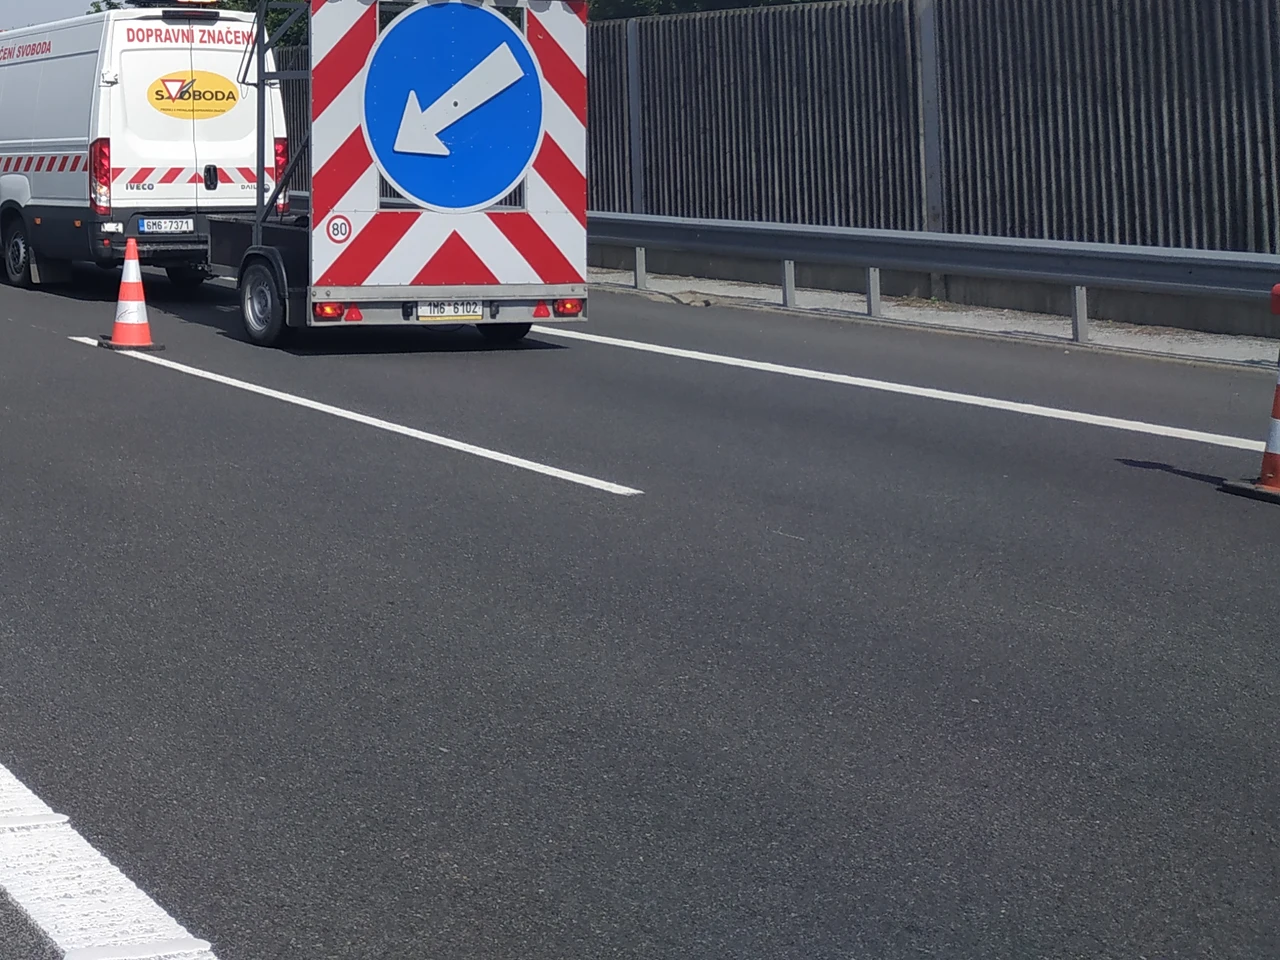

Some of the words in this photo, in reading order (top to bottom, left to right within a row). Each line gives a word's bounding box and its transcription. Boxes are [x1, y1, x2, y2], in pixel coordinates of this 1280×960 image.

[126, 25, 195, 44] DOPRAVNÍ
[16, 41, 52, 58] SVOBODA
[125, 183, 155, 191] IVECO
[146, 220, 163, 230] 6M6
[168, 220, 189, 230] 7371
[332, 222, 348, 236] 80
[428, 301, 446, 315] 1M6
[453, 301, 478, 314] 6102
